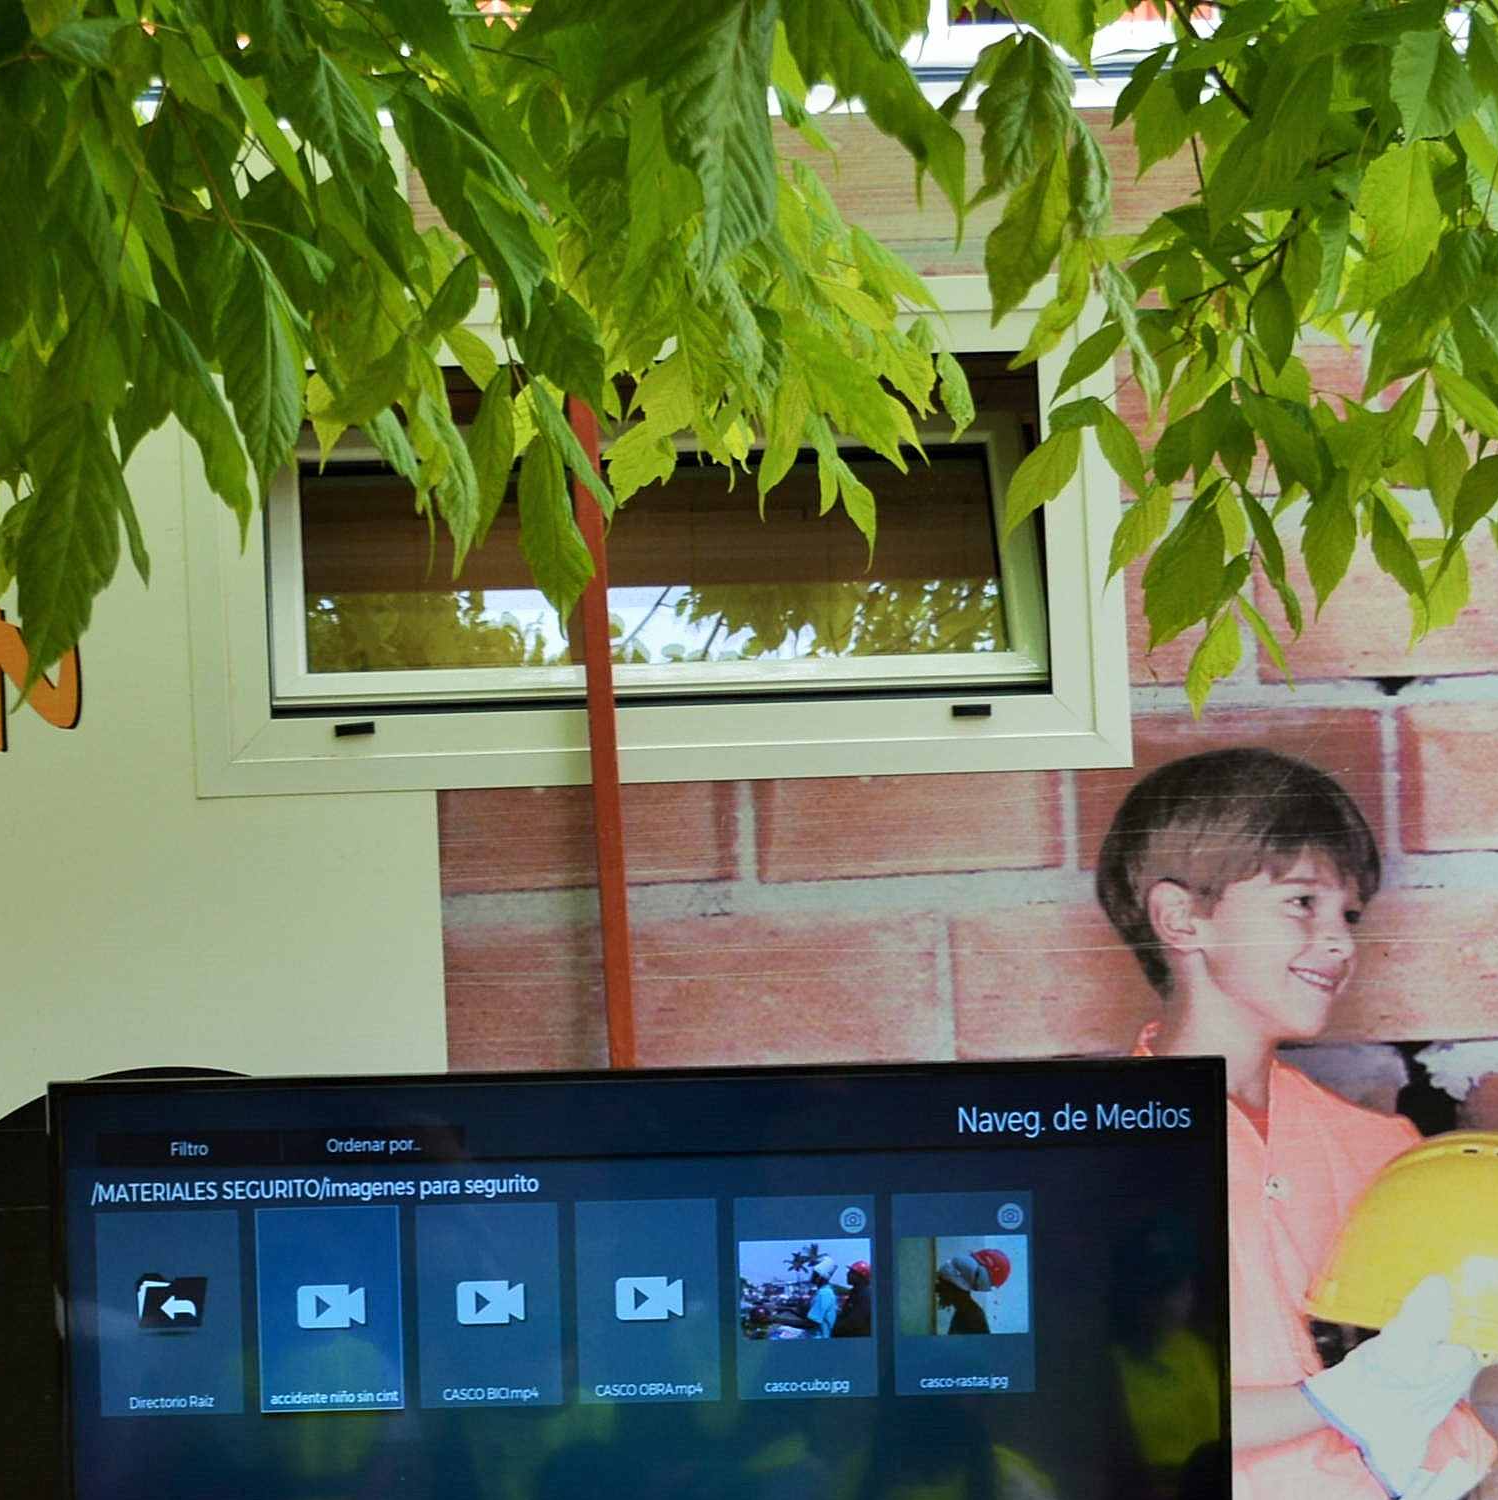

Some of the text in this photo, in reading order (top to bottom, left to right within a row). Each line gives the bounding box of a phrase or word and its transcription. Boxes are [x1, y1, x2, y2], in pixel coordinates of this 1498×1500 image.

[957, 1100, 1191, 1138] Naveg. de Medios
[170, 1141, 209, 1156] Filtro
[326, 1138, 385, 1153] Ordenar
[90, 1173, 539, 1206] /MATERIALES SEGURITO/imagenes para segurito
[764, 1379, 850, 1393] casco-cubo.jpg
[919, 1374, 1009, 1389] casco-rastas.jpg
[270, 1391, 328, 1405] accidente
[329, 1390, 355, 1404] niño
[356, 1390, 374, 1403] sin
[442, 1387, 486, 1401] CASCO
[595, 1383, 638, 1398] CASCO
[129, 1396, 188, 1410] Directorio
